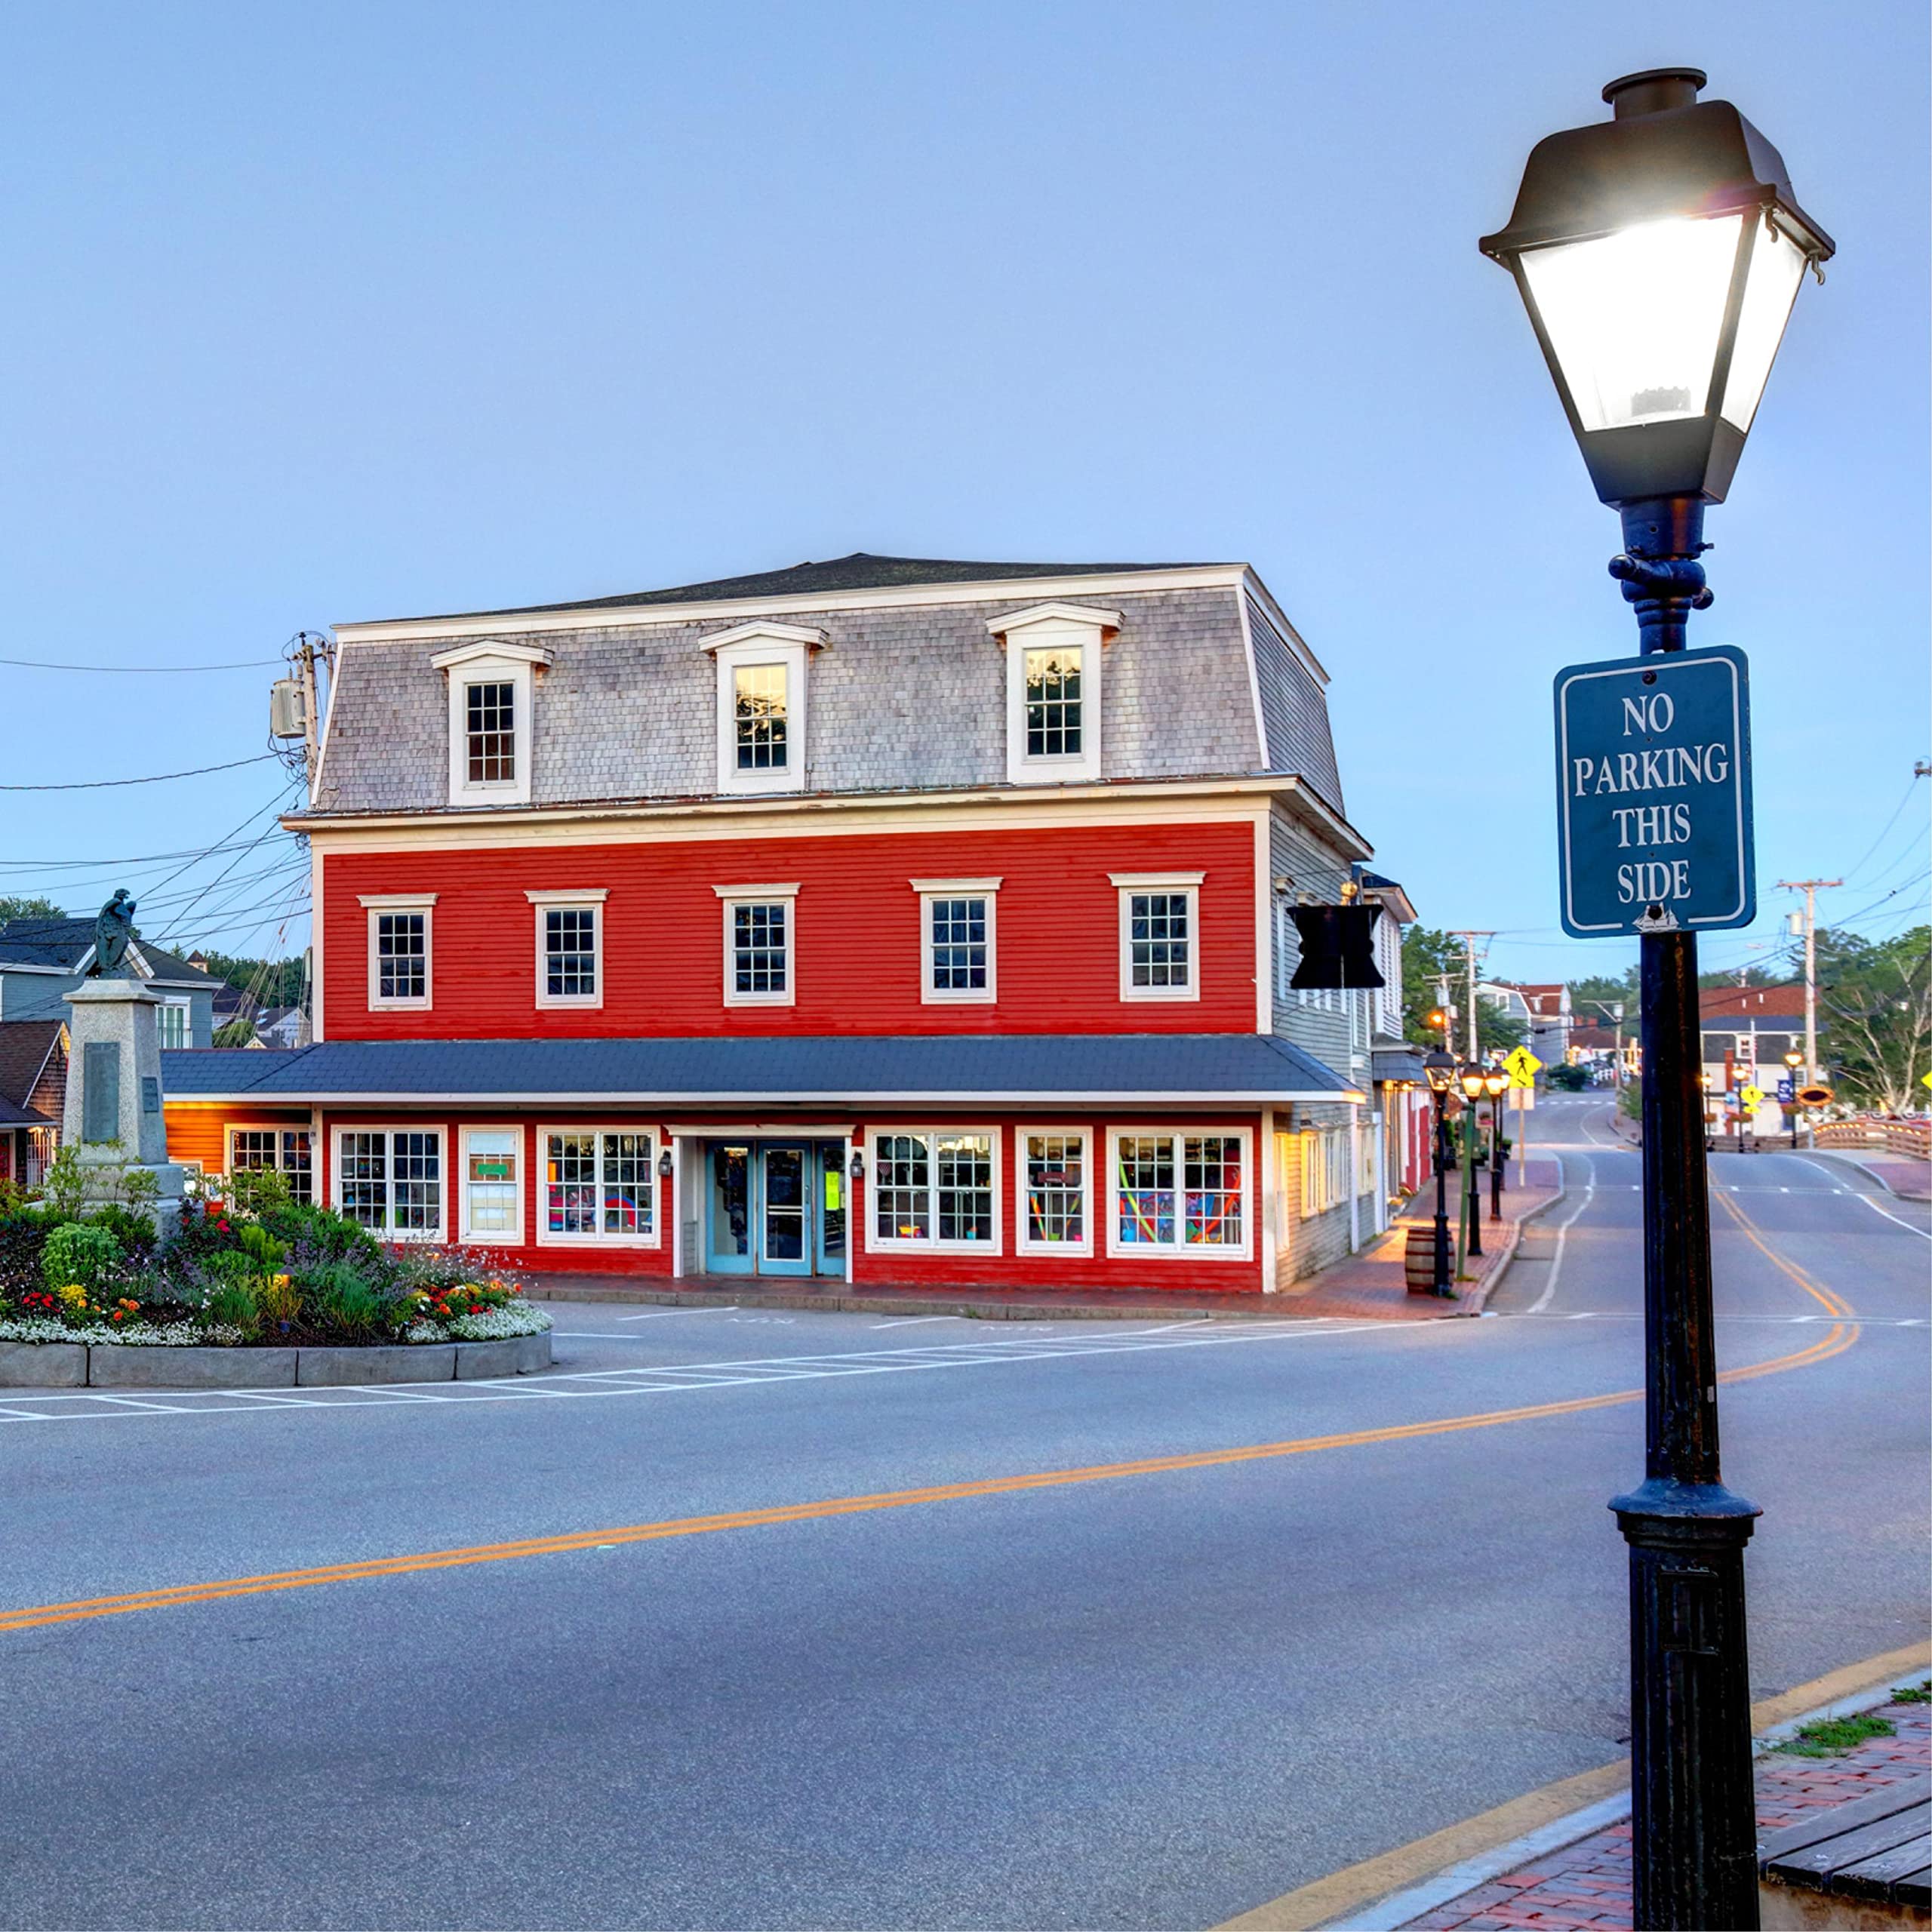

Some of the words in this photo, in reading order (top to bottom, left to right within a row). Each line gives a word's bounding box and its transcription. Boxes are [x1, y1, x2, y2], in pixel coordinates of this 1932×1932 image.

[1622, 693, 1674, 736] NO
[1574, 743, 1728, 796] PARKING
[1612, 804, 1690, 848] THIS
[1618, 860, 1691, 903] SIDE
